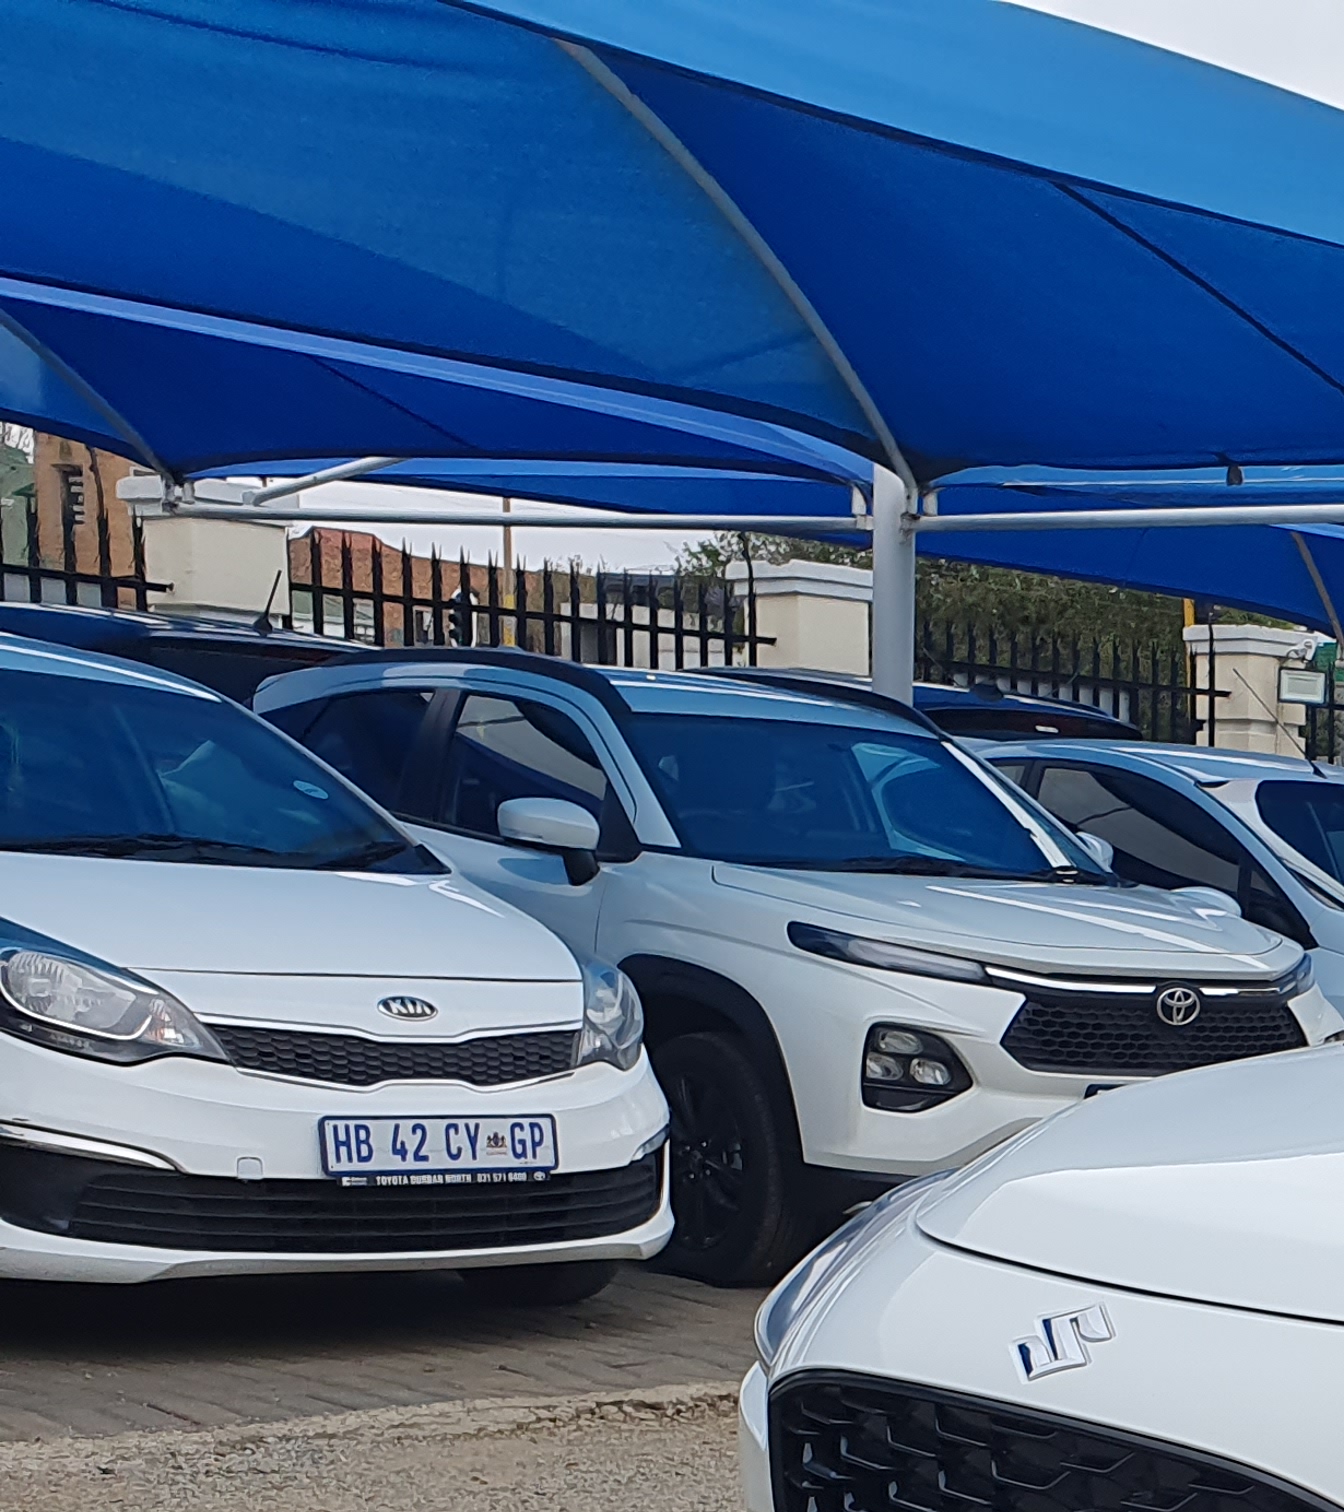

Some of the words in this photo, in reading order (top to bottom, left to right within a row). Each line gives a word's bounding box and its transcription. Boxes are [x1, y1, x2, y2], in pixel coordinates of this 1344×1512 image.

[386, 998, 433, 1015] KIA
[332, 1123, 374, 1164] HB
[391, 1122, 430, 1163] 42
[444, 1121, 481, 1161] CY
[510, 1121, 545, 1160] GP
[376, 1175, 409, 1187] TOYOTA
